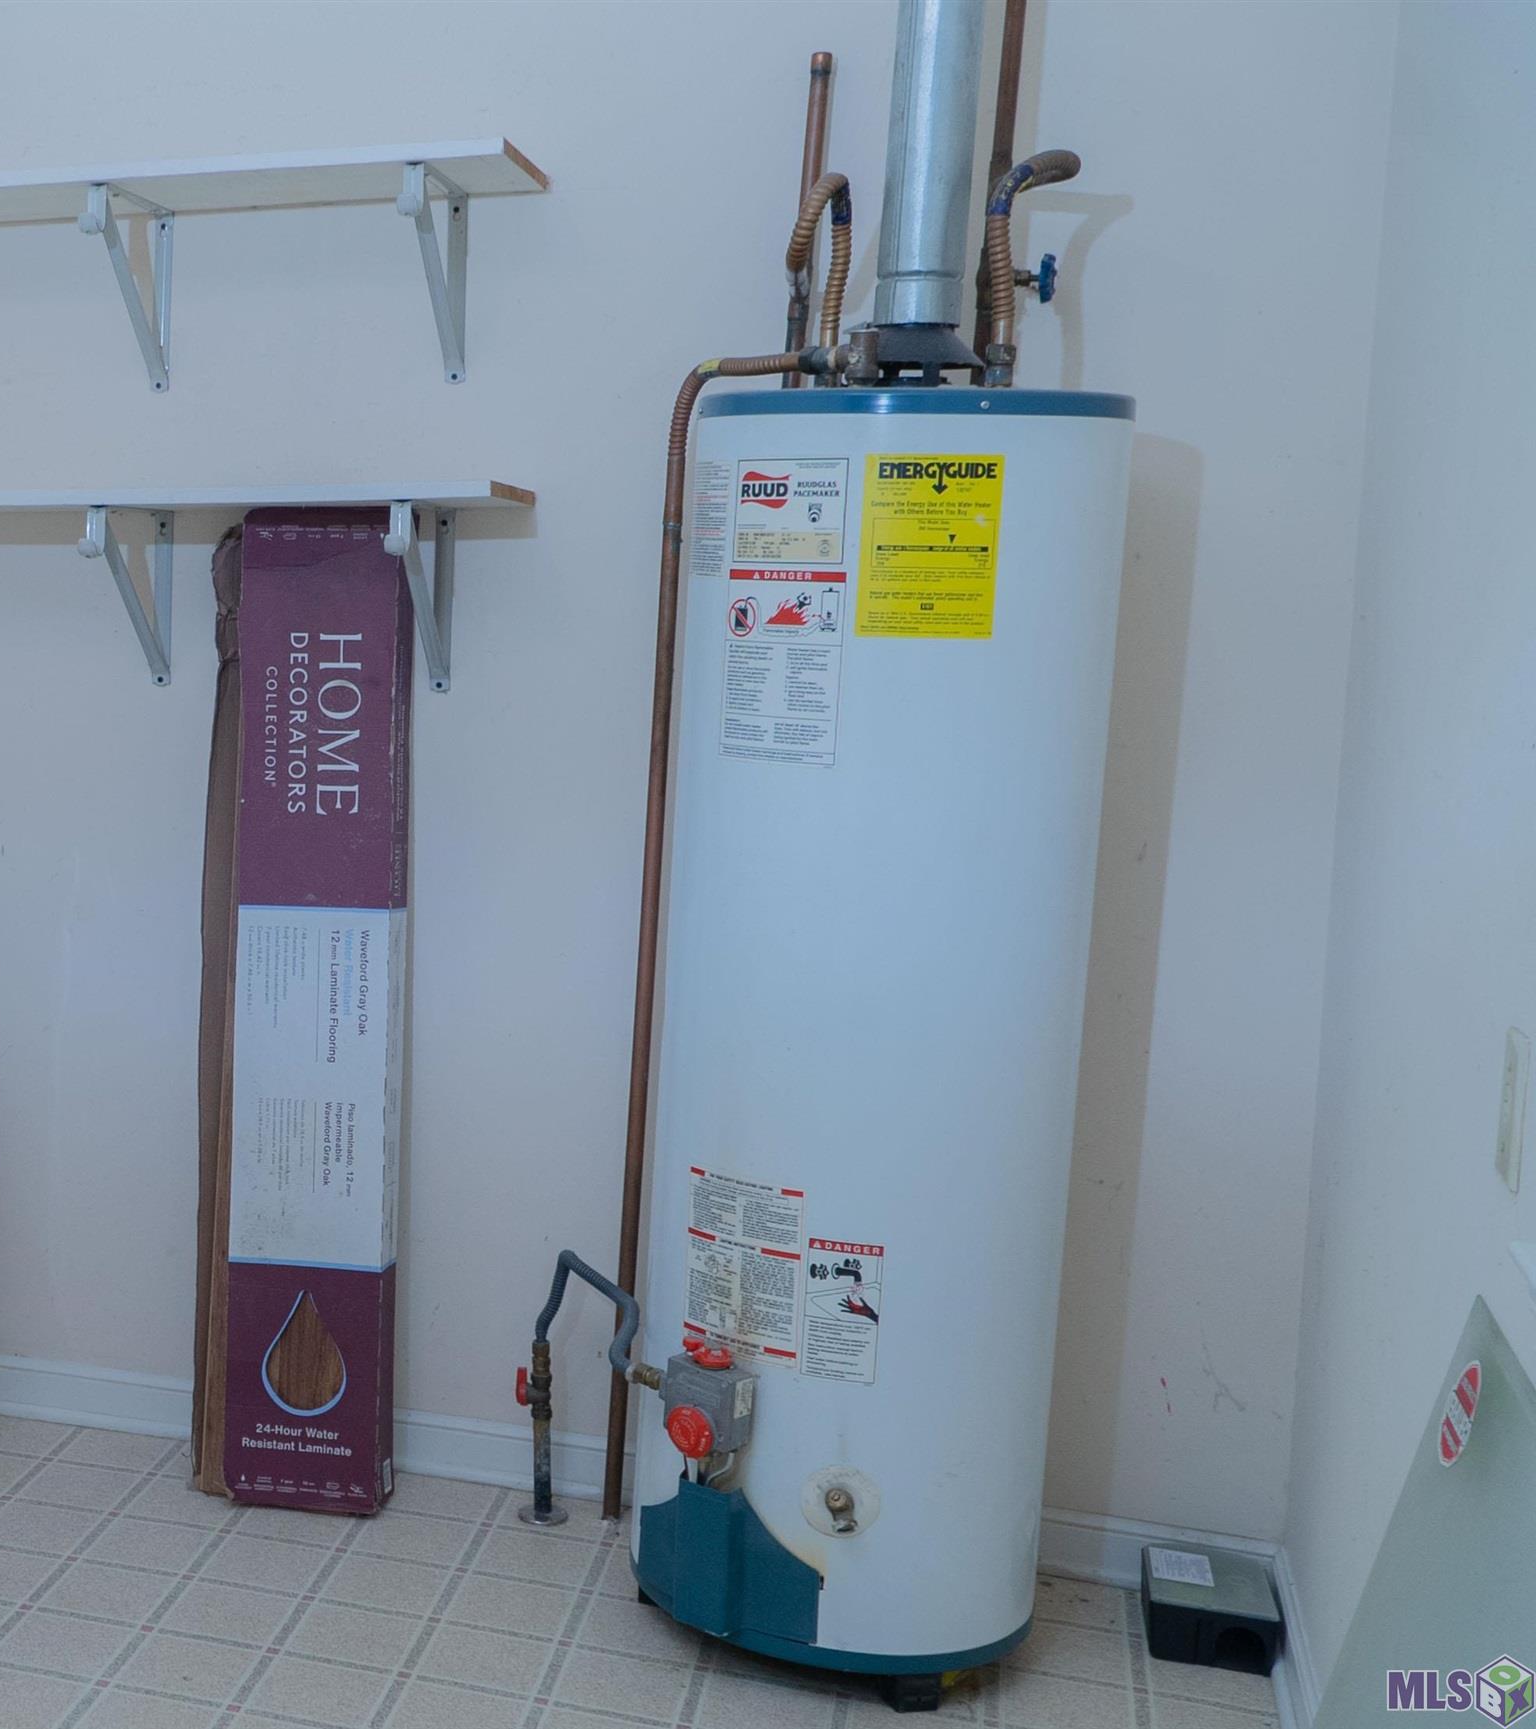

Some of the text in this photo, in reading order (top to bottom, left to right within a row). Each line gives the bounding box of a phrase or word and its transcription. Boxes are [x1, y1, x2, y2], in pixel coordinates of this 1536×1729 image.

[879, 462, 997, 480] ENERGYGUIDE
[741, 482, 788, 498] RUUD
[793, 489, 840, 498] PACEMAKER
[797, 481, 837, 489] RUUDGLAS
[871, 500, 894, 508] Compare
[763, 571, 812, 581] DANGER
[287, 632, 309, 814] DECORATORS
[316, 632, 363, 816] HOME
[343, 929, 354, 1016] Water Resistant
[357, 930, 370, 1036] Waveford Gray Oak
[329, 963, 339, 1014] Laminate
[326, 1018, 338, 1063] Flooring
[323, 1102, 332, 1143] Waveford
[347, 1103, 356, 1122] Piso
[322, 1145, 331, 1166] Gray
[346, 1124, 355, 1168] laminado,
[825, 1241, 880, 1255] DANGER
[255, 1423, 339, 1441] 24-Hour Water
[241, 1436, 352, 1457] Resistant Laminate
